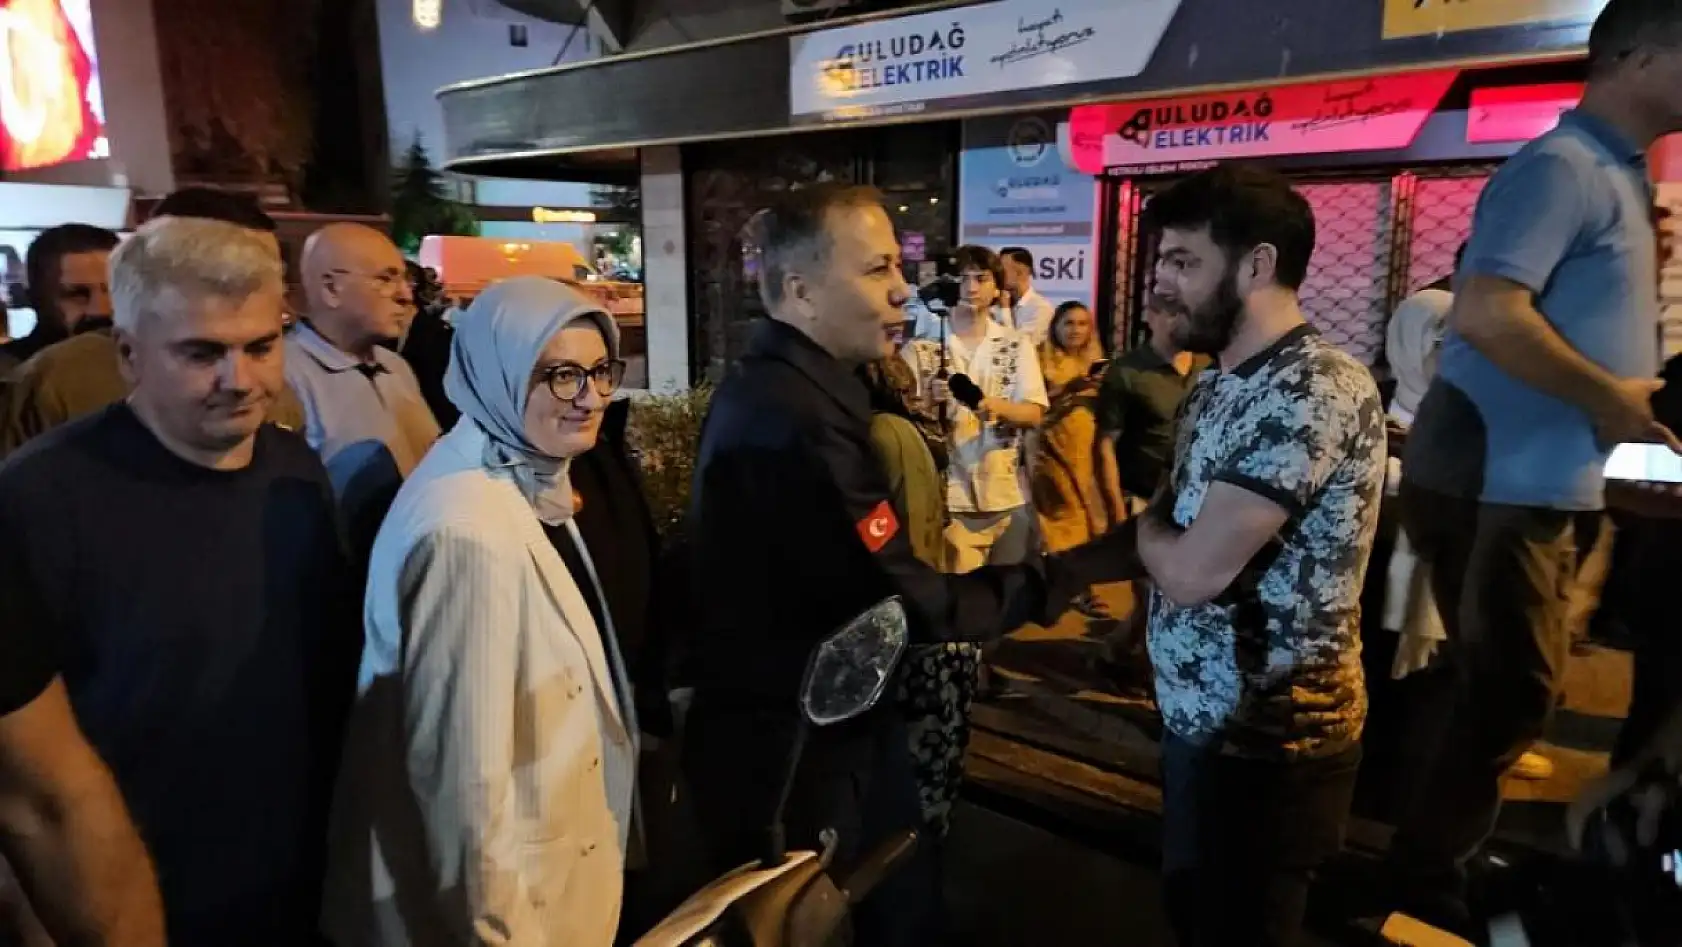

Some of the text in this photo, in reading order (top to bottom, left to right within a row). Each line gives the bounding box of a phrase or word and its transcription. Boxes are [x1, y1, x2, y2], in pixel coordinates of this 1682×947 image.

[858, 22, 965, 62] ULUDAĞ
[859, 53, 965, 88] ELEKTRİK
[1156, 92, 1273, 125] ULUDAĞ
[1155, 122, 1270, 149] ELEKTRİK
[1032, 250, 1085, 281] SKİ
